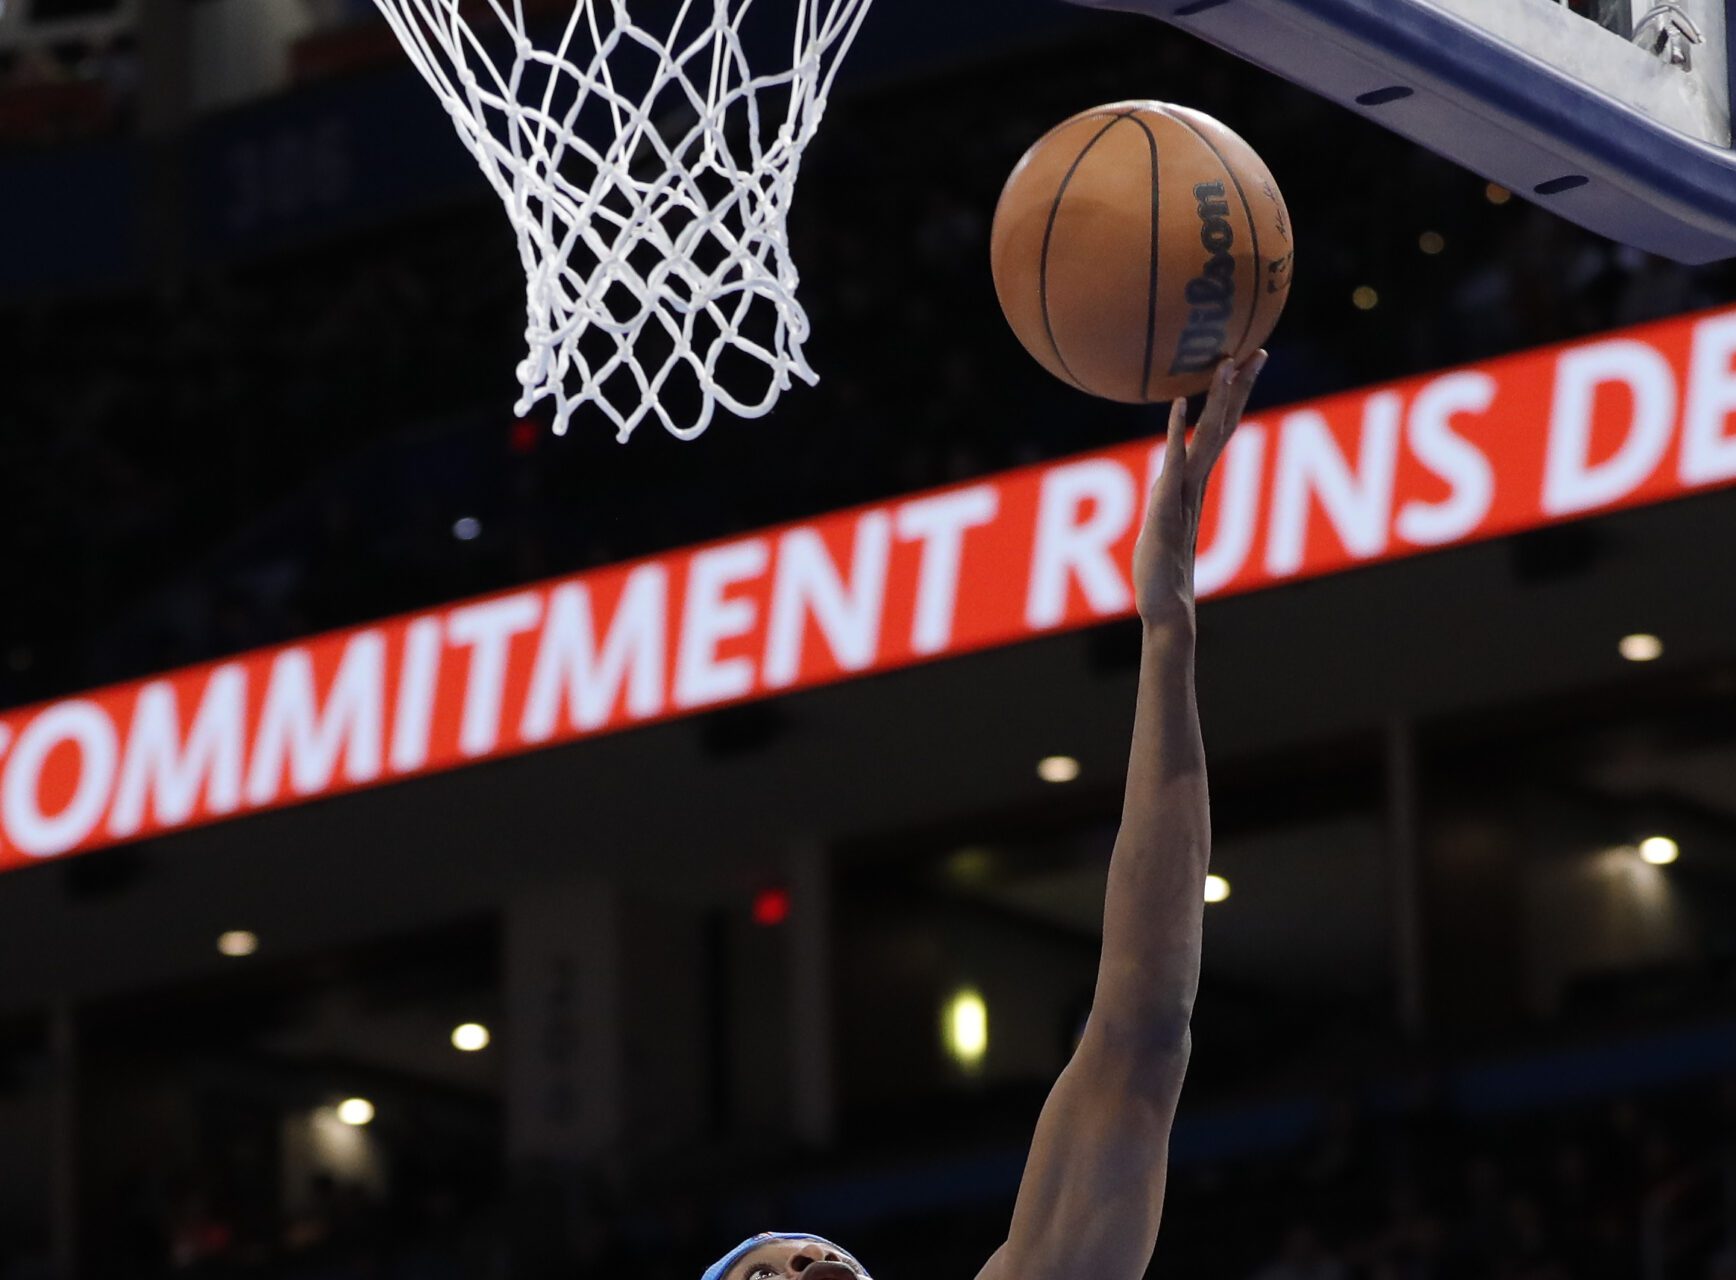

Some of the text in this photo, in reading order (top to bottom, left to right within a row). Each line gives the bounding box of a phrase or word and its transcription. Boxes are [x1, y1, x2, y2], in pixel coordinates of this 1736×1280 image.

[1169, 181, 1236, 376] Wilson
[0, 486, 998, 858] OMMITMENT
[1025, 370, 1496, 631] RUNS
